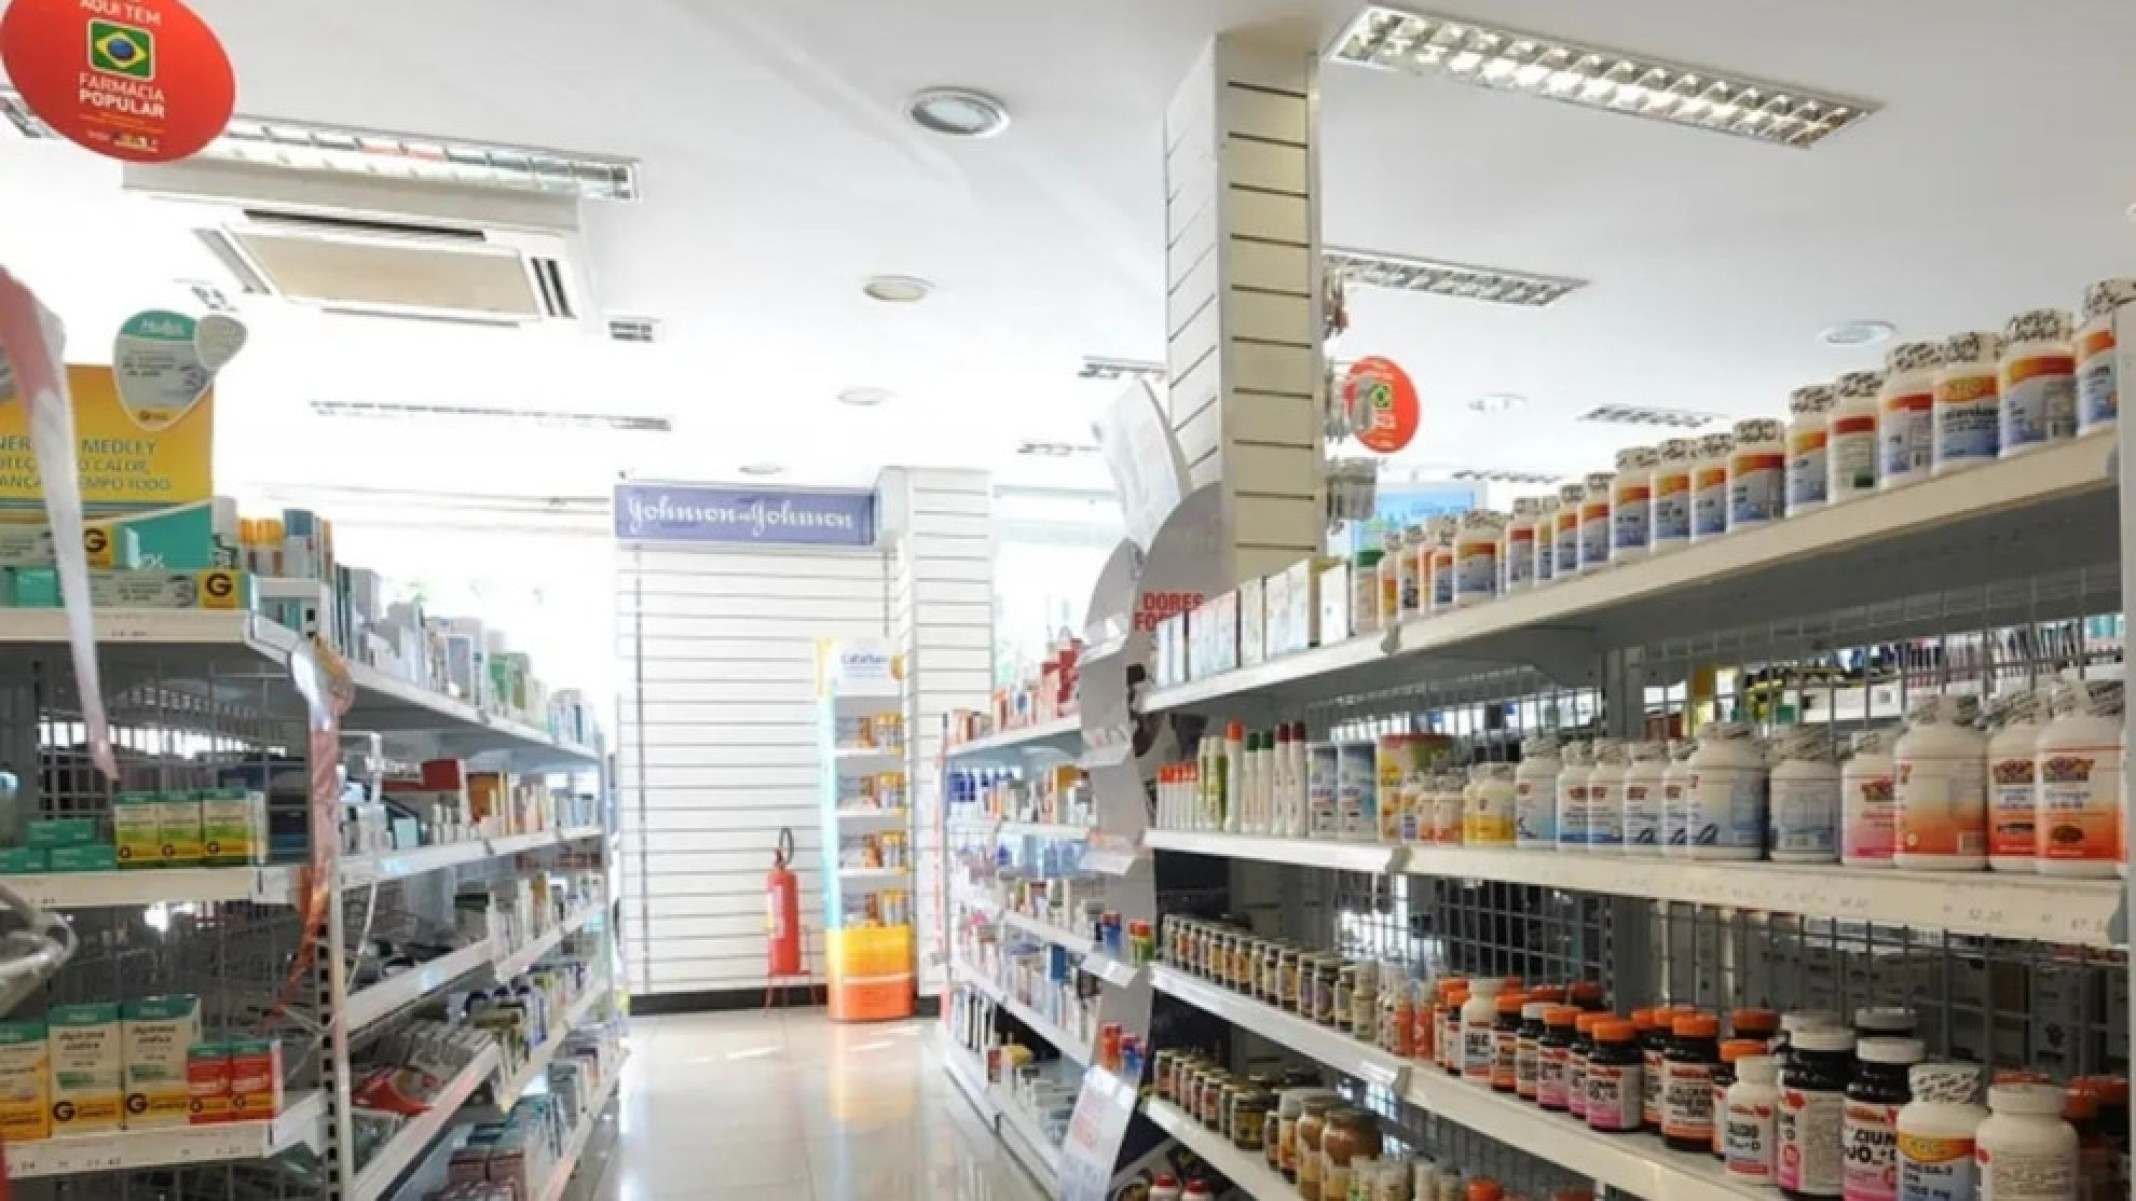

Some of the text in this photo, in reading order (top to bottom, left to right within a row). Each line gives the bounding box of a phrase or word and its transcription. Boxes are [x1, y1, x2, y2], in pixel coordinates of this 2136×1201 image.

[123, 2, 162, 27] TEM
[79, 88, 165, 118] POPULAR
[81, 439, 156, 454] MEDLEY
[83, 527, 107, 552] G
[206, 572, 233, 597] G
[53, 1101, 76, 1122] G
[126, 1092, 148, 1114] G
